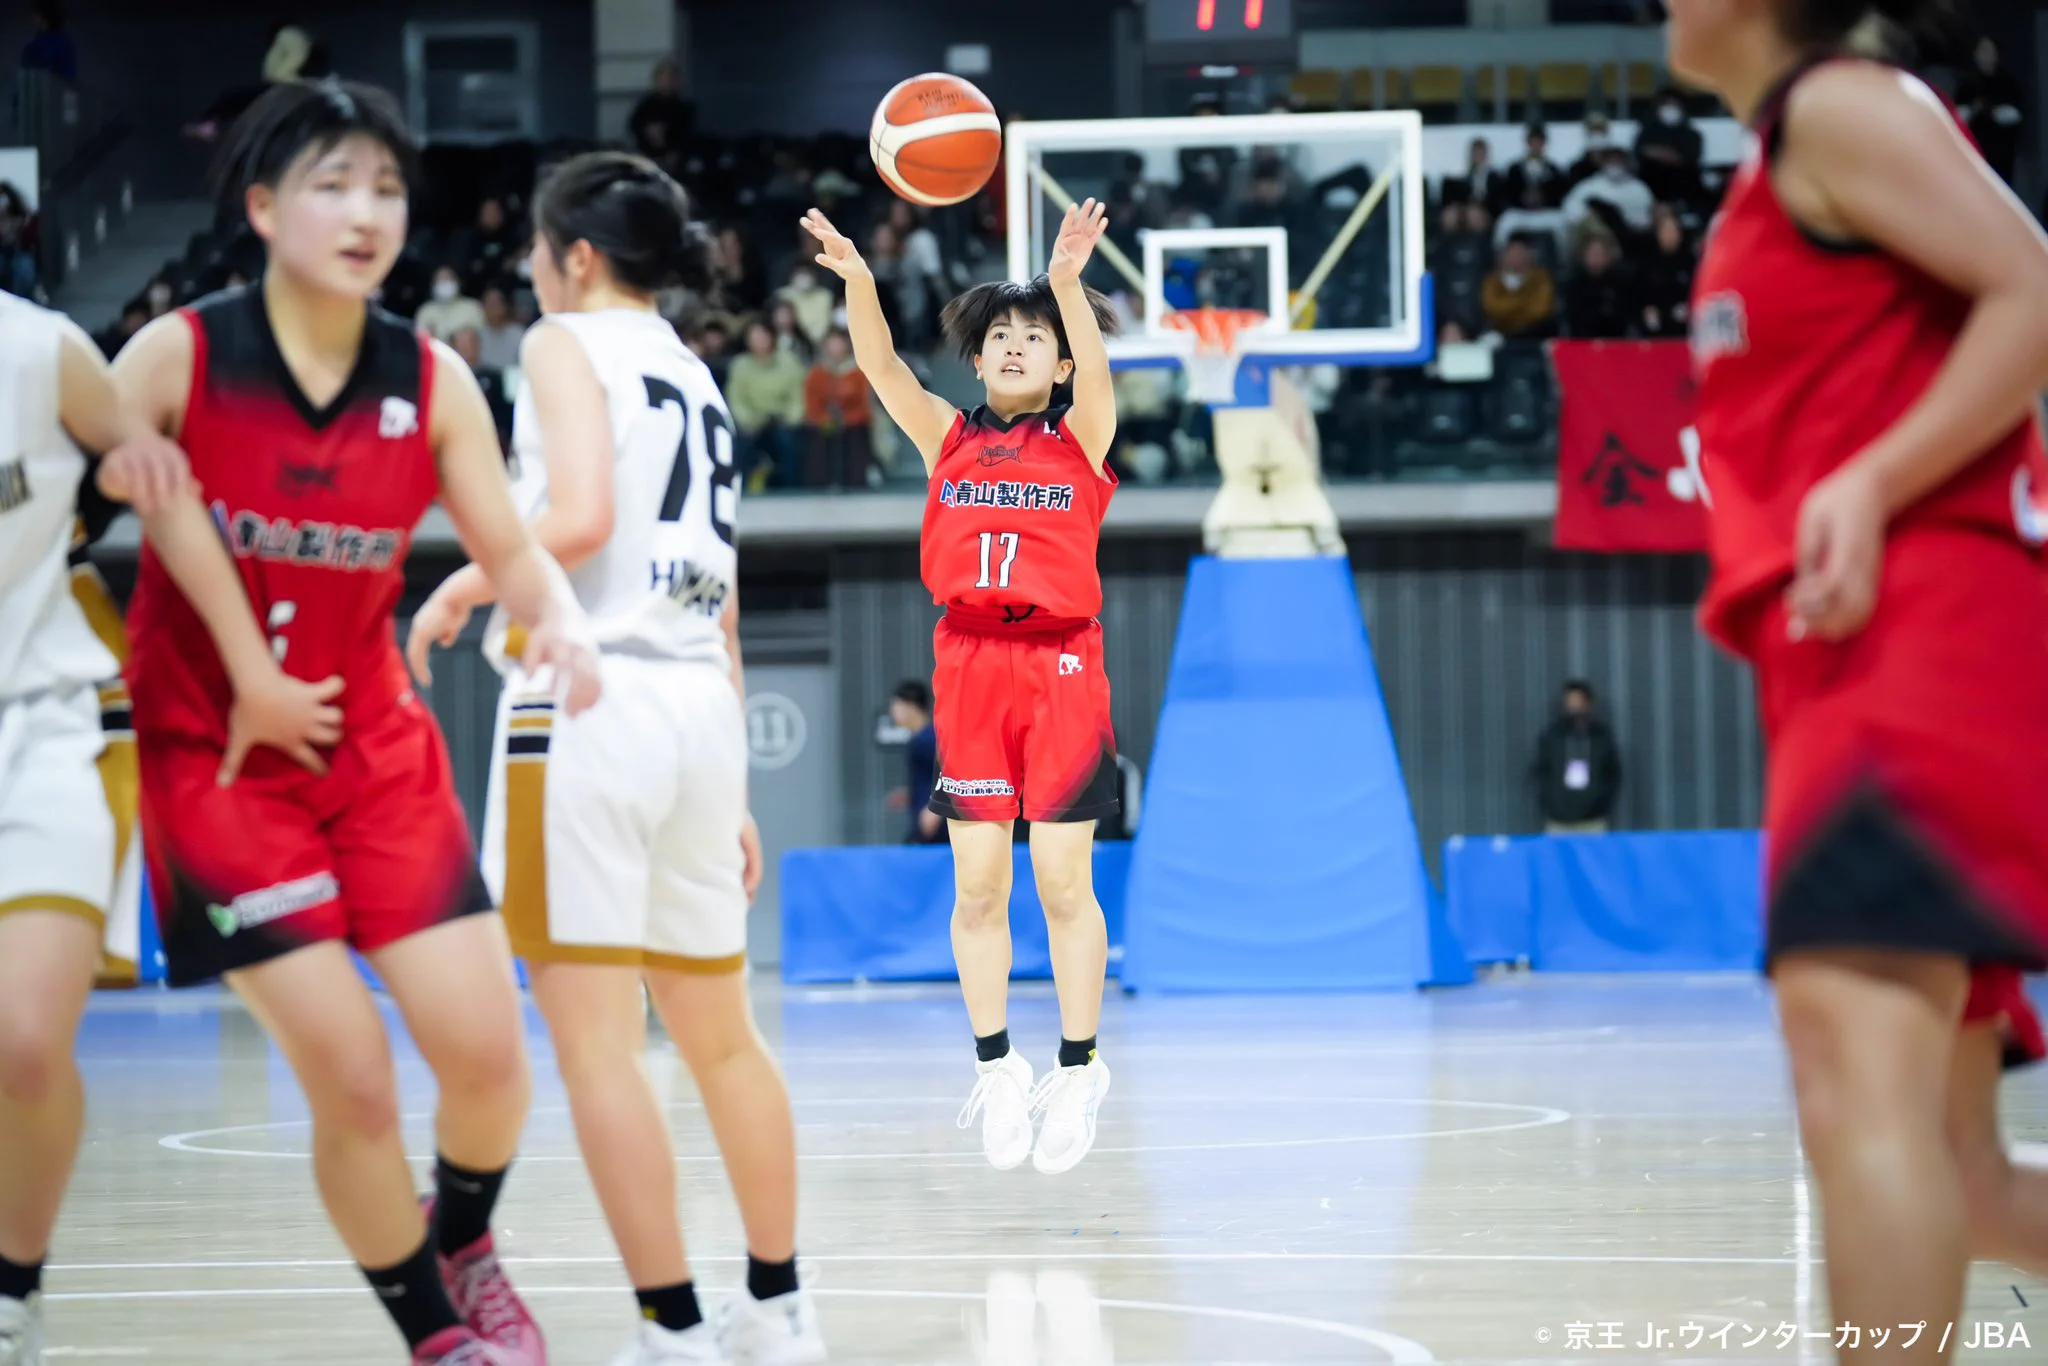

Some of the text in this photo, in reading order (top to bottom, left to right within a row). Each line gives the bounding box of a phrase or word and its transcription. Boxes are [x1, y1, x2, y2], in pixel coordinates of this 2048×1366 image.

[641, 374, 738, 547] 78
[956, 481, 1073, 510] 青山製作所
[975, 531, 1020, 588] 17
